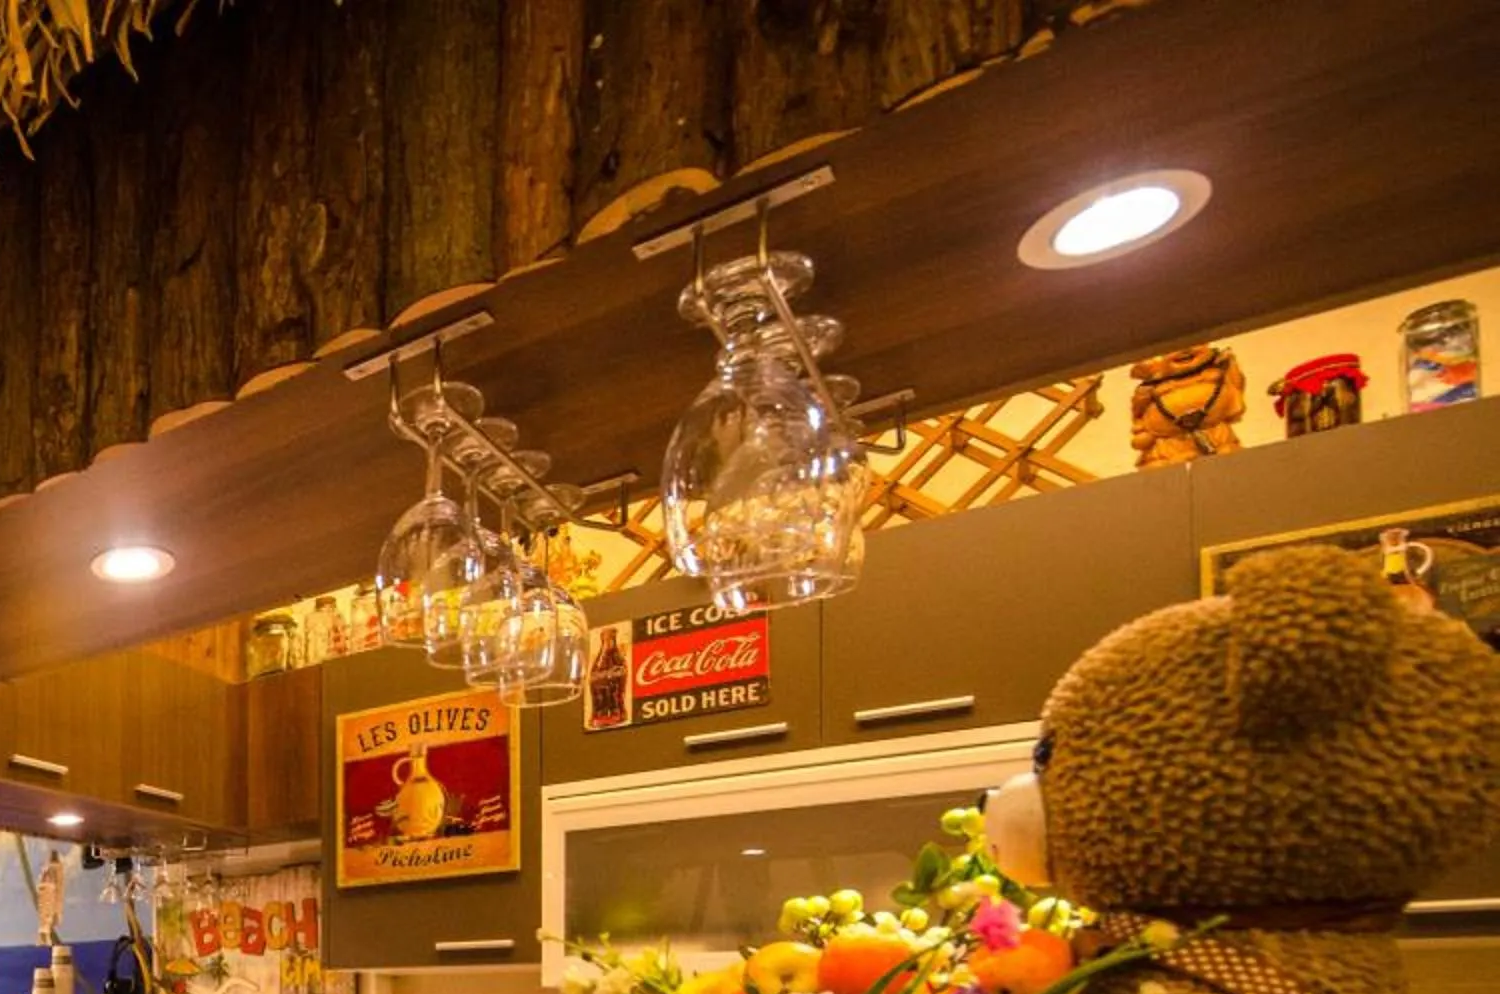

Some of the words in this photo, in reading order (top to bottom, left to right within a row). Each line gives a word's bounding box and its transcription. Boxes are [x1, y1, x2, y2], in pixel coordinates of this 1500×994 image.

[646, 611, 683, 635] ICE
[641, 694, 696, 719] SOLD
[701, 683, 761, 709] HERE
[357, 720, 397, 753] LES
[408, 706, 491, 735] OLIVES
